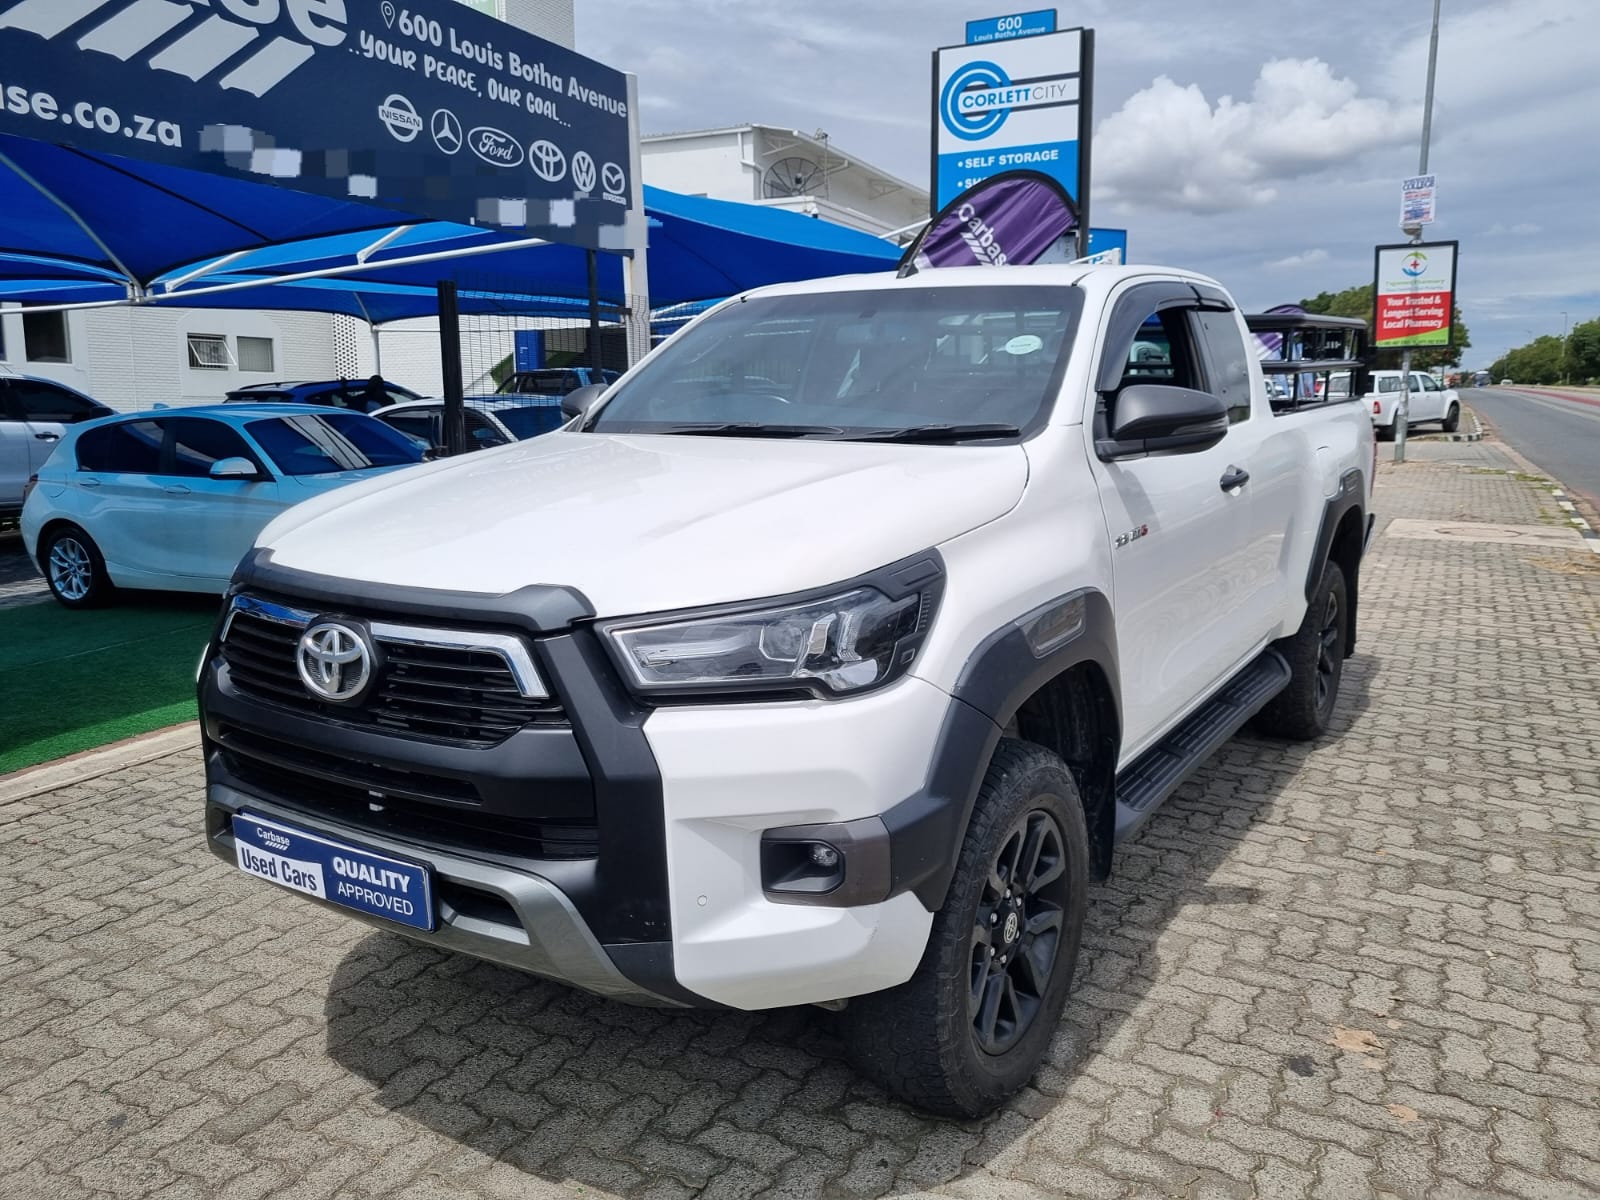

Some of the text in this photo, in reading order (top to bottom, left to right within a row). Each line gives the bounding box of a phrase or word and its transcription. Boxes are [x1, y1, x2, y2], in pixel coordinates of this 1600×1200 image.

[997, 15, 1023, 31] 600
[398, 9, 628, 119] 600 Louis Botha Avenue
[487, 78, 522, 108] OUR
[380, 108, 421, 130] NISSAN
[478, 132, 514, 161] Ford
[965, 149, 1060, 169] SELF STORAGE
[1383, 306, 1445, 319] Longest Serving
[1386, 297, 1404, 307] Your
[1405, 296, 1434, 306] Trusted
[1383, 318, 1443, 329] Local Pharmacy
[256, 827, 291, 847] Carbase
[241, 847, 318, 892] Used Cars
[332, 856, 411, 893] QUALITY
[337, 881, 414, 916] APPROVED
